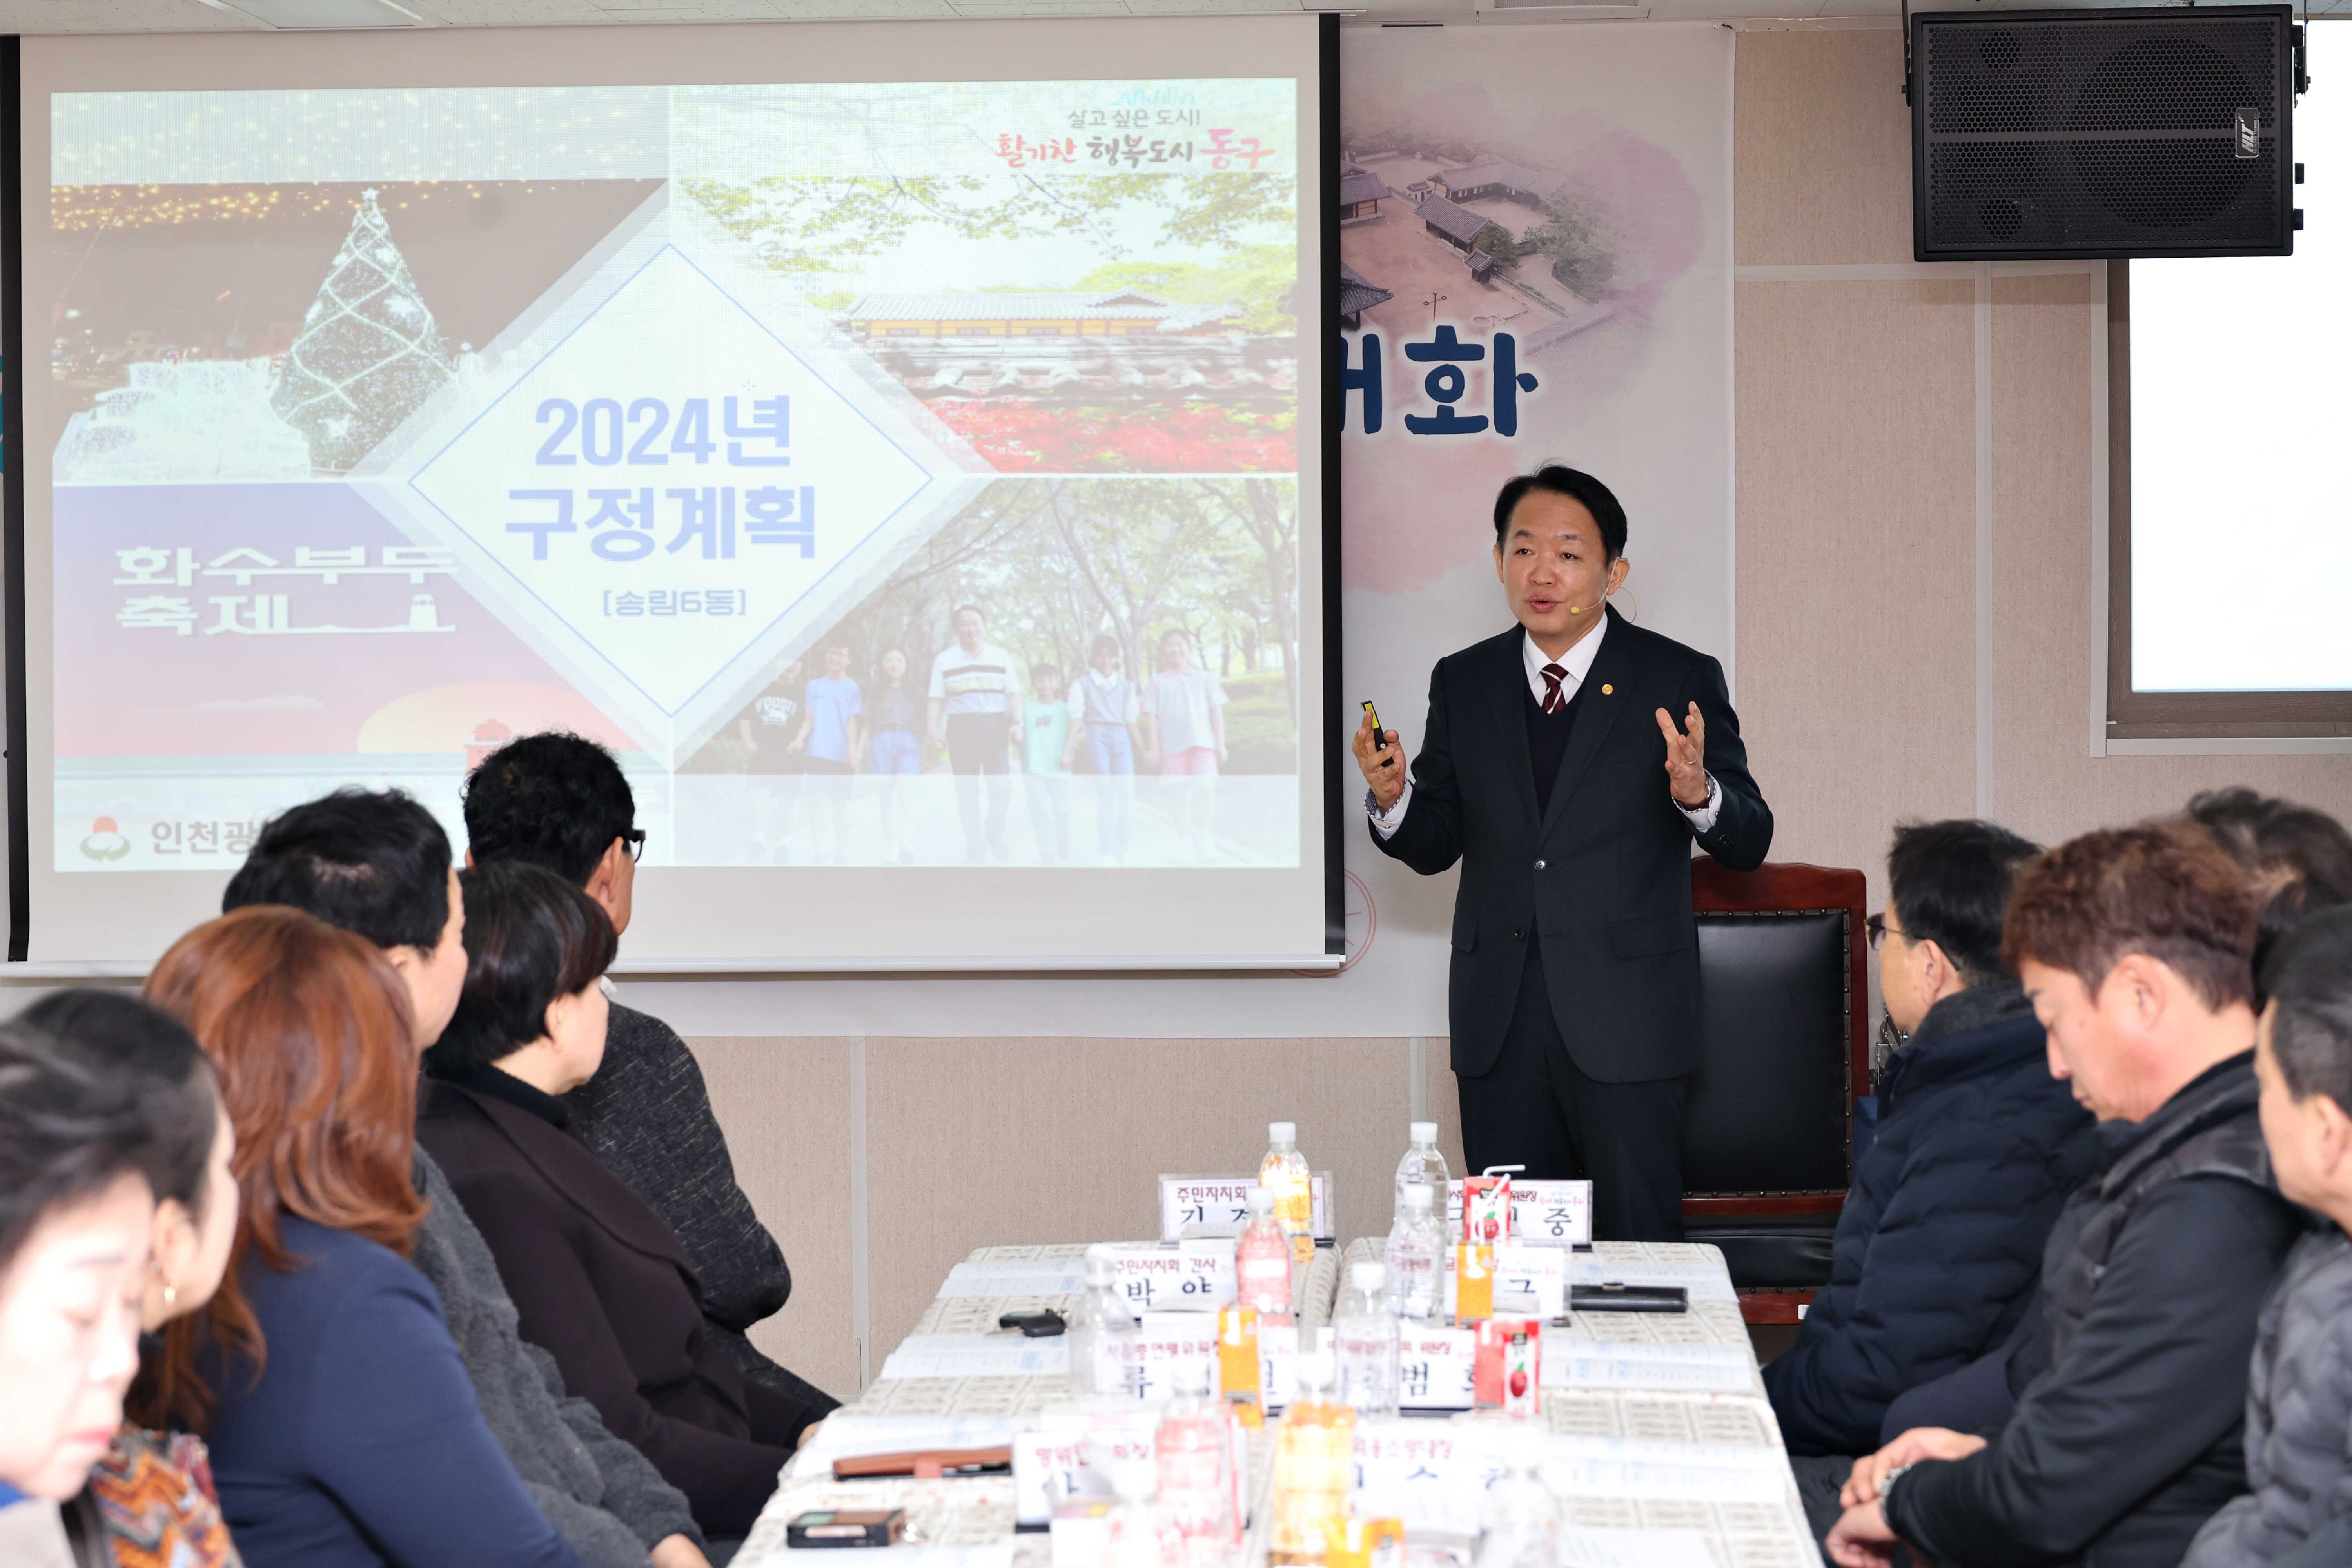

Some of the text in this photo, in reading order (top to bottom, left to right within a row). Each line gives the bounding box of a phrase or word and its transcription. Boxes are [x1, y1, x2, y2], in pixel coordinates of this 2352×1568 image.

[1067, 109, 1201, 129] 살고 싶은 도시!
[995, 127, 1277, 170] 활기찬 행복도시 동구
[2241, 123, 2254, 154] HLT
[535, 395, 791, 467] 2024년
[505, 486, 815, 561] 구정계획
[113, 546, 458, 586] 화수부두
[602, 589, 746, 617] [송림6동]
[1543, 1207, 1572, 1236] 중
